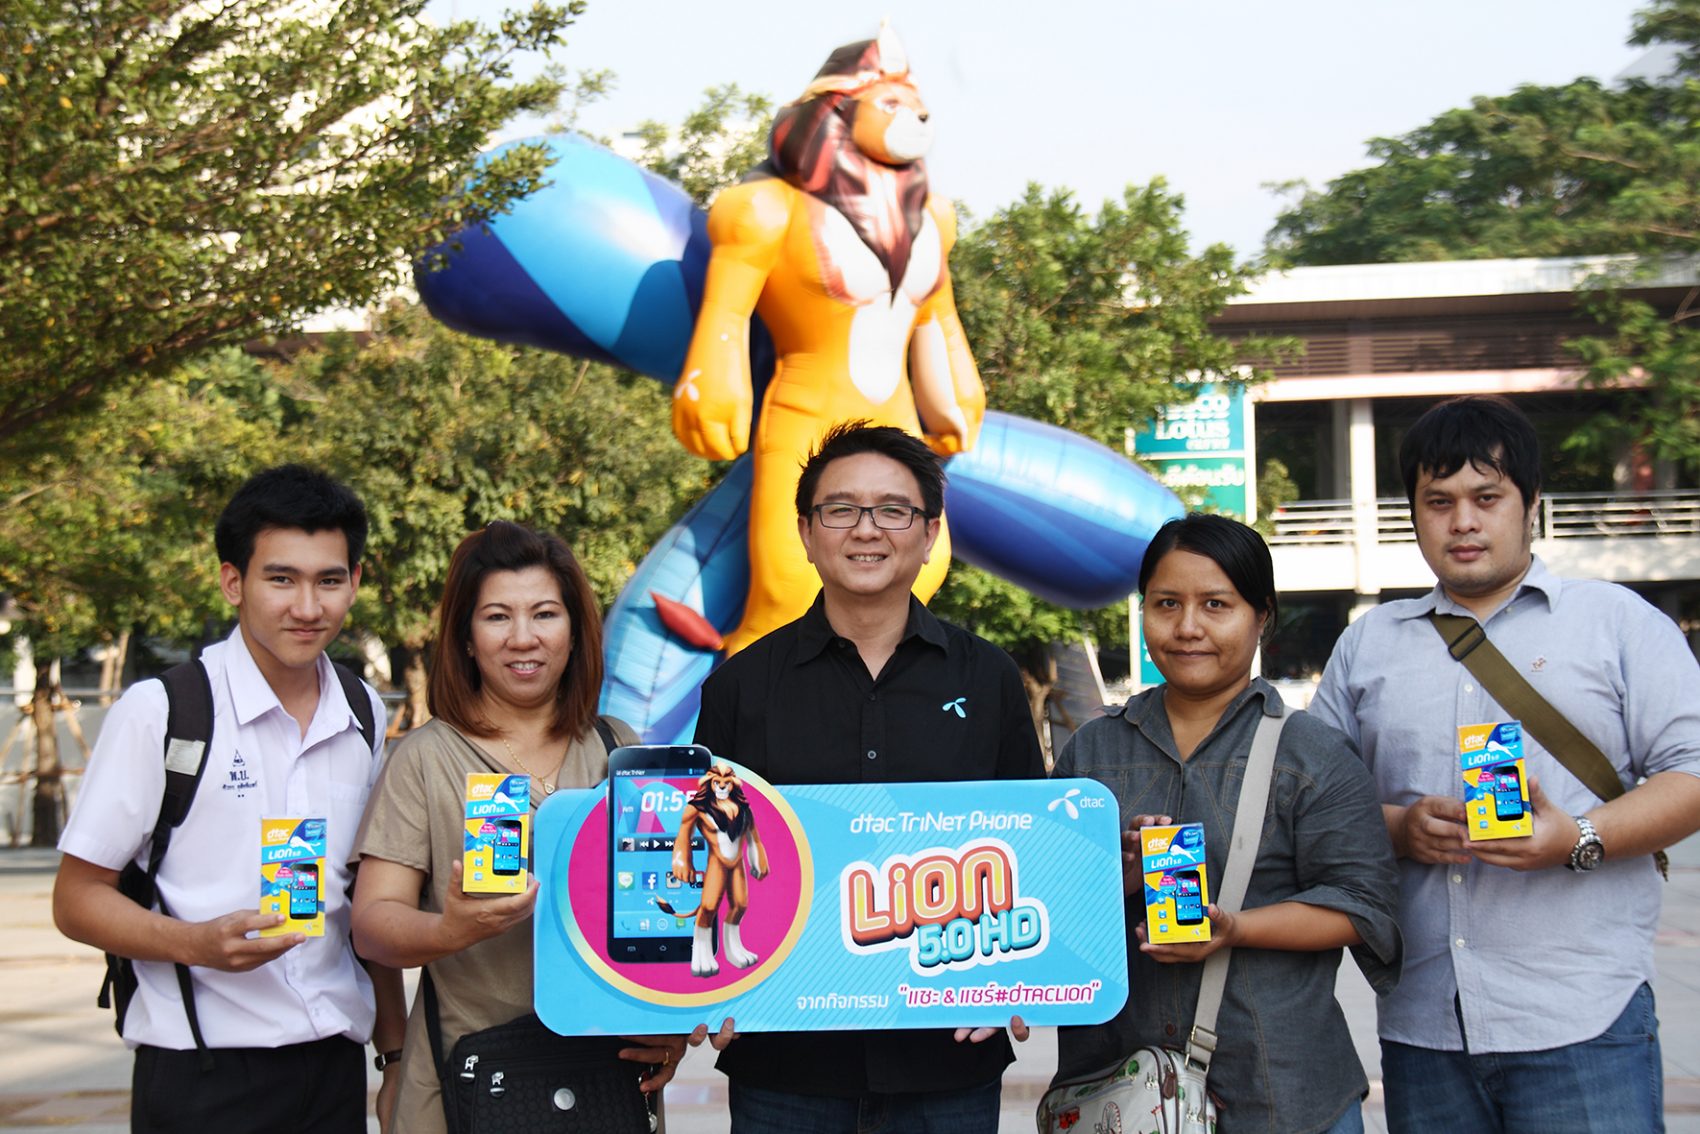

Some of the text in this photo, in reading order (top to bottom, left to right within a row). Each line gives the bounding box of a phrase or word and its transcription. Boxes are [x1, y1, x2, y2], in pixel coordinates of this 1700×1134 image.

[1080, 796, 1105, 809] dtac
[850, 813, 895, 833] dtac
[918, 905, 1042, 968] 5.0 HD
[797, 993, 889, 1010] จากกิจกรรม
[943, 989, 955, 1004] &
